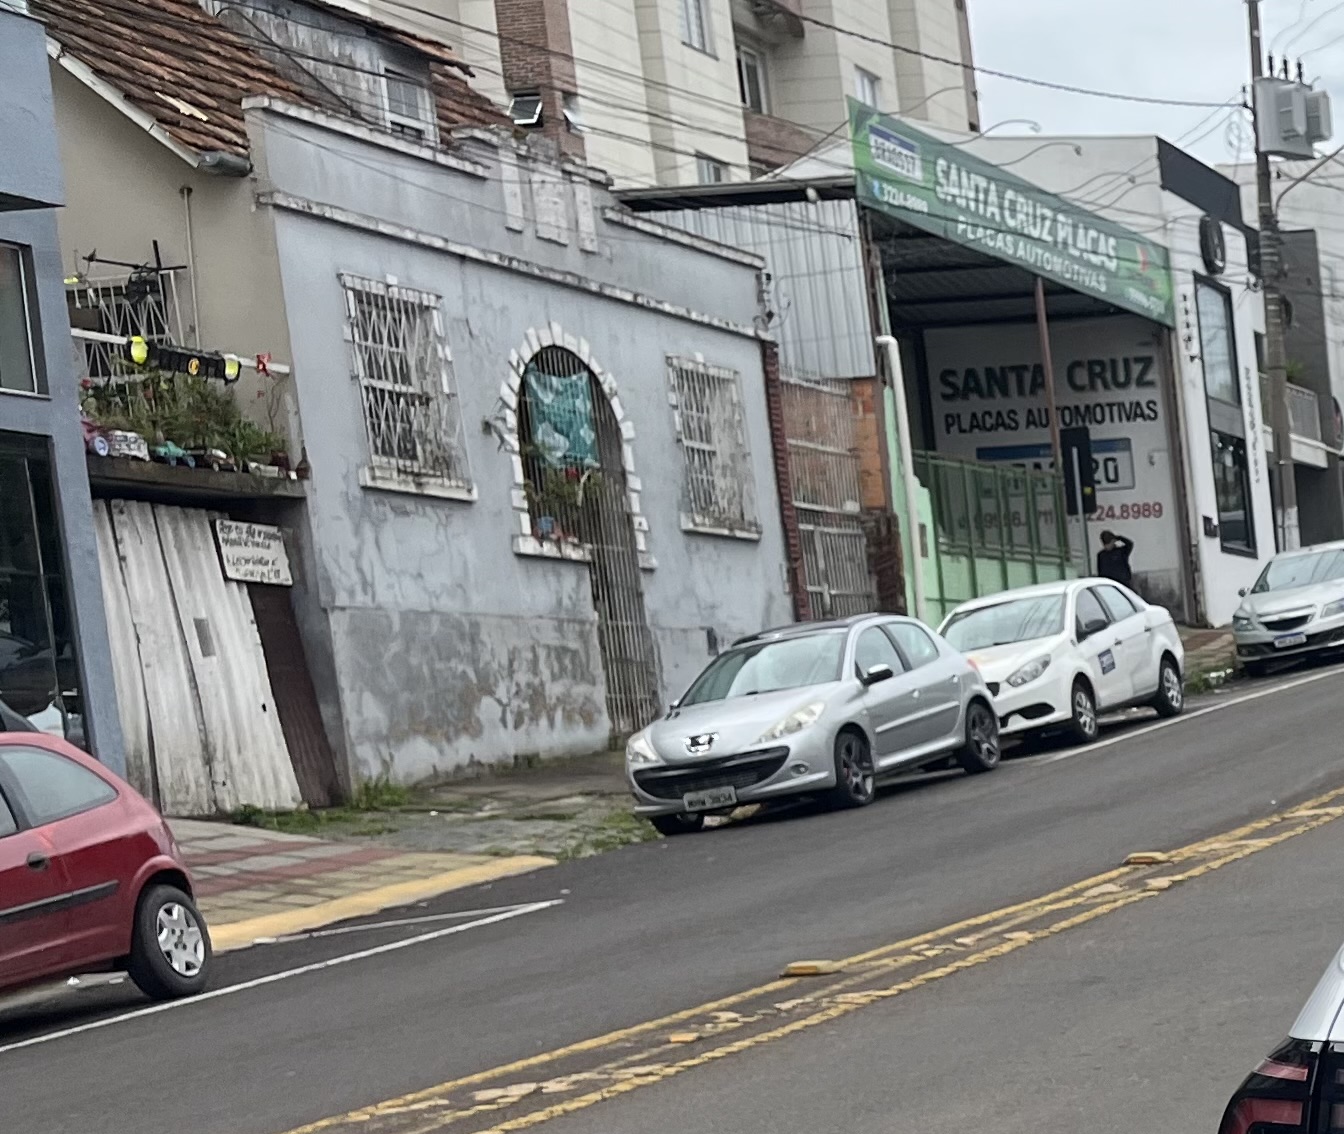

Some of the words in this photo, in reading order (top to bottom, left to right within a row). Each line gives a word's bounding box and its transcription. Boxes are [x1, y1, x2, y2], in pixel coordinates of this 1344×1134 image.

[935, 157, 1001, 223] SANTA
[1003, 188, 1054, 242] CRUZ
[1056, 213, 1118, 272] PLACAS
[957, 215, 1015, 255] PLACAS
[1016, 241, 1107, 292] AUTOMOTIVAS
[939, 363, 1048, 402] SANTA
[1066, 356, 1156, 392] CRUZ
[944, 408, 1020, 435] PLACAS
